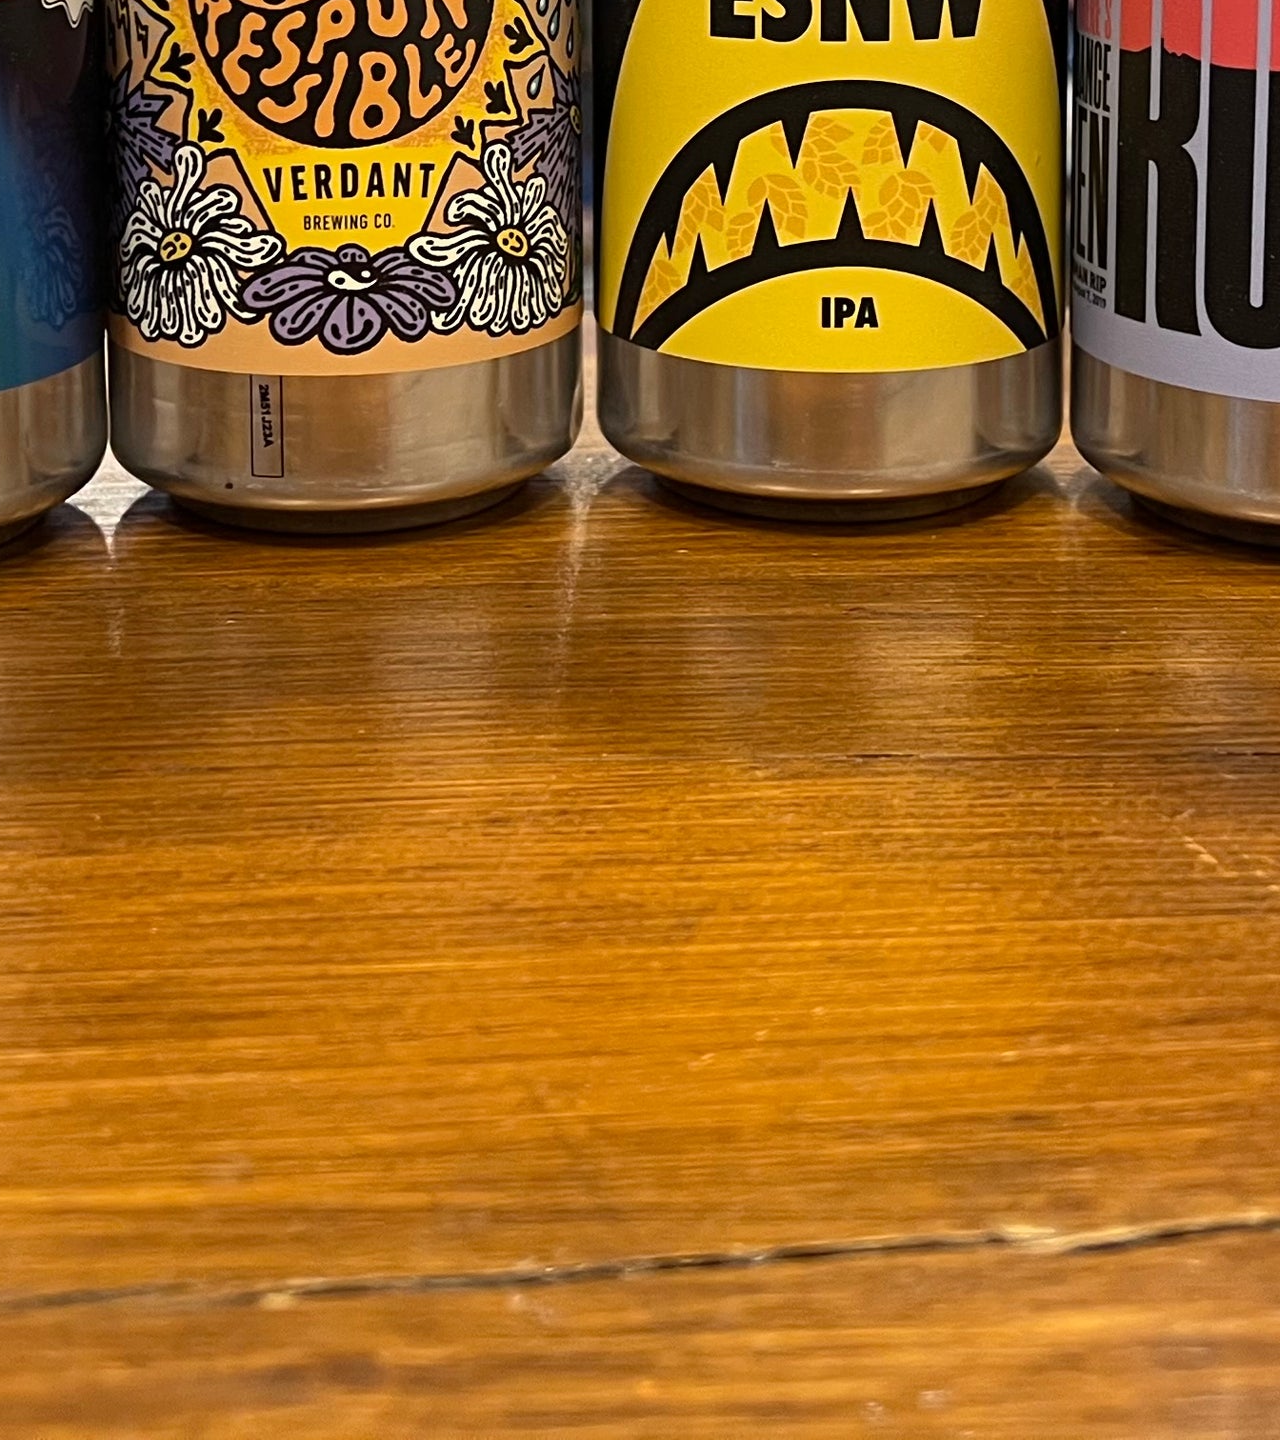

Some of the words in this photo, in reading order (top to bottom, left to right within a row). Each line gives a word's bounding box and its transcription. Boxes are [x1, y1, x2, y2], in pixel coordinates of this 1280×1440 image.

[263, 160, 437, 205] VERDANT
[303, 212, 369, 232] BREWING
[373, 213, 396, 231] CO.
[820, 295, 879, 329] IPA
